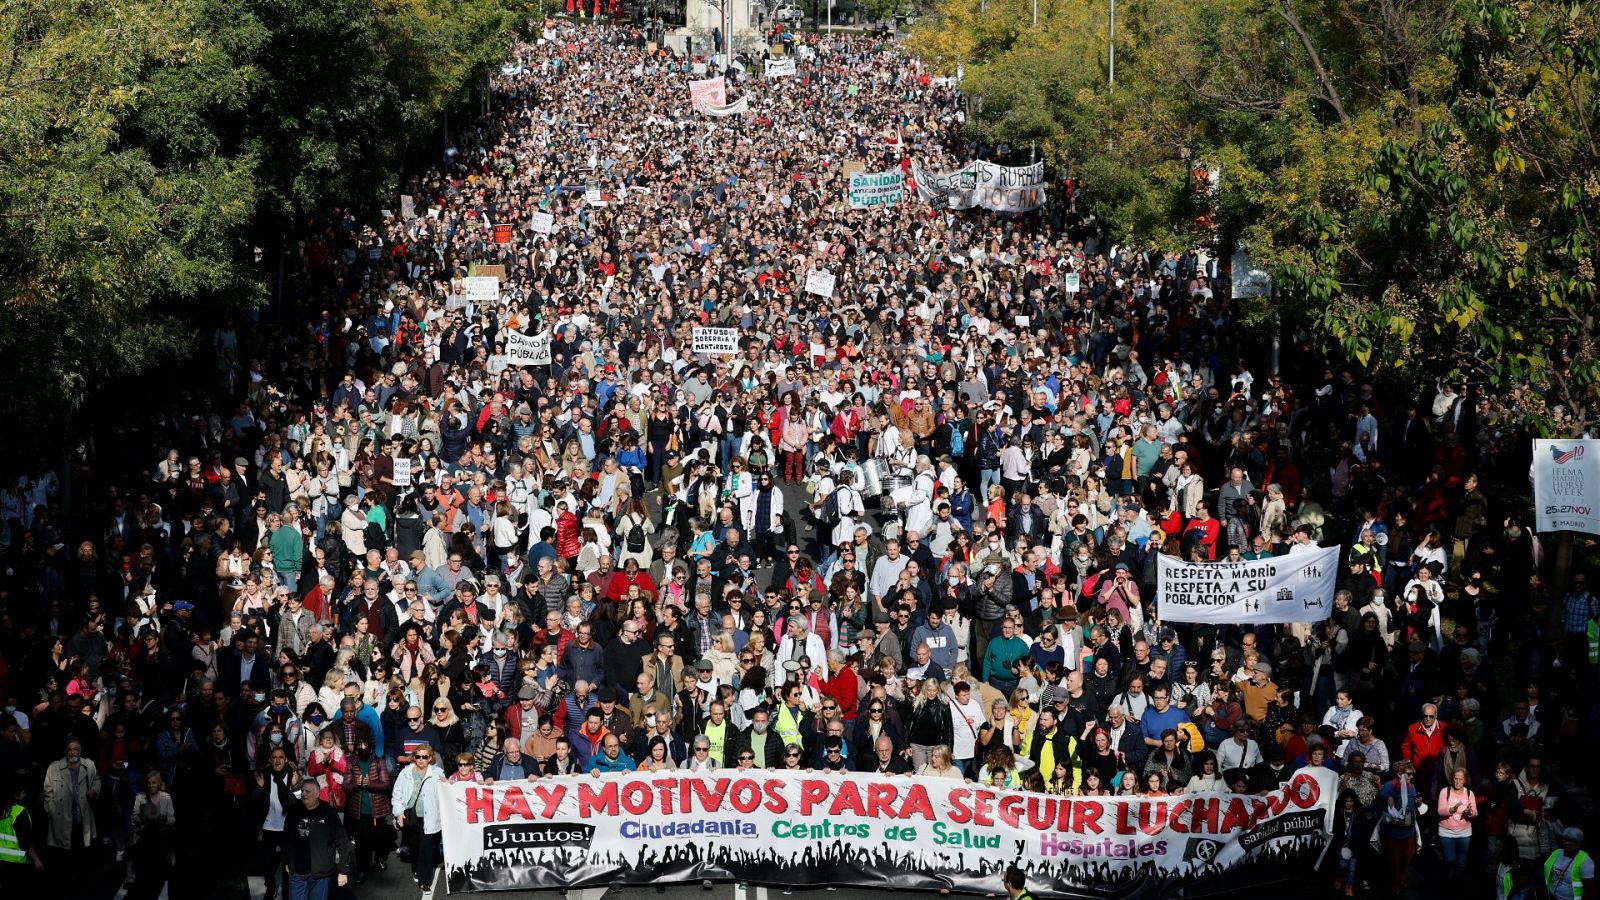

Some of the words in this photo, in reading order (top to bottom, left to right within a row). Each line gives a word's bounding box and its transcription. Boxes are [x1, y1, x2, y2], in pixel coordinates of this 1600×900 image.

[510, 346, 549, 360] PÚBLICA
[1574, 445, 1585, 457] 10
[1552, 481, 1585, 489] HORSE
[1553, 489, 1584, 497] WEEK
[1166, 568, 1223, 579] RESPETA
[1166, 582, 1222, 593] RESPETA
[1230, 581, 1239, 593] A
[1248, 579, 1266, 591] SU
[1166, 591, 1235, 605] POBLACIÓN
[465, 784, 567, 823] HAY
[578, 778, 788, 819] MOTIVOS
[800, 779, 937, 821] PARA
[947, 787, 1105, 835] SEGUIR
[486, 826, 591, 847] ¡Juntos!
[772, 818, 870, 841] Centros
[884, 825, 917, 842] de
[932, 822, 1001, 849] Salud
[1015, 839, 1026, 855] y
[1040, 832, 1168, 860] Hospitales
